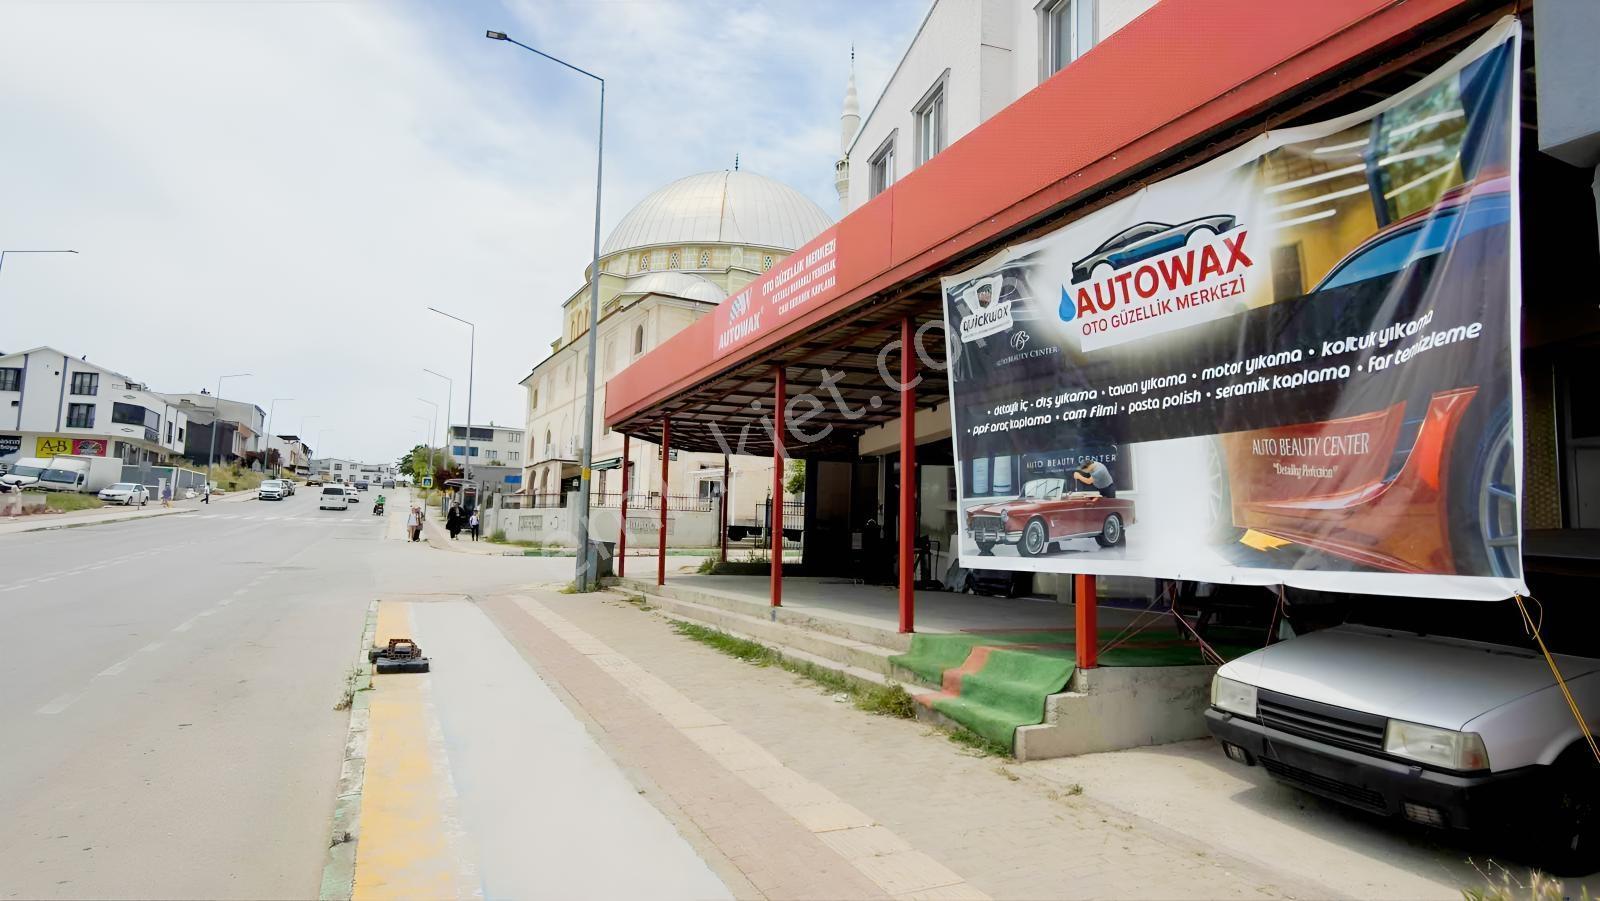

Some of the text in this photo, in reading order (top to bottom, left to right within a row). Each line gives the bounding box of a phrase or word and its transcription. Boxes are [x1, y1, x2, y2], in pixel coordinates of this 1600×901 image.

[762, 279, 774, 296] OTO
[1077, 230, 1253, 319] AUTOWAX
[1082, 273, 1246, 336] OTO GÜZELLİK MERKEZİ
[973, 422, 990, 437] ppf
[1010, 414, 1052, 430] kaplama
[1063, 408, 1087, 422] cam
[1090, 402, 1118, 418] filmi
[1128, 397, 1160, 415] pasta
[1162, 389, 1202, 410] polish
[1215, 376, 1270, 400] seramik
[1272, 364, 1351, 390] kaplama
[1367, 353, 1394, 374] far
[1394, 322, 1483, 365] temizleme
[1020, 399, 1029, 412] iç
[1036, 396, 1053, 409] dış
[1055, 390, 1098, 409] yıkama
[1108, 382, 1139, 396] tavan
[1141, 373, 1187, 395] yıkama
[1201, 360, 1243, 381] motor
[1245, 349, 1303, 375] yıkama
[1321, 331, 1378, 357] koltuk
[1378, 310, 1434, 348] yıkama
[1047, 457, 1075, 467] BEAUTY
[1252, 432, 1370, 457] AUTO BEAUTY CENTER
